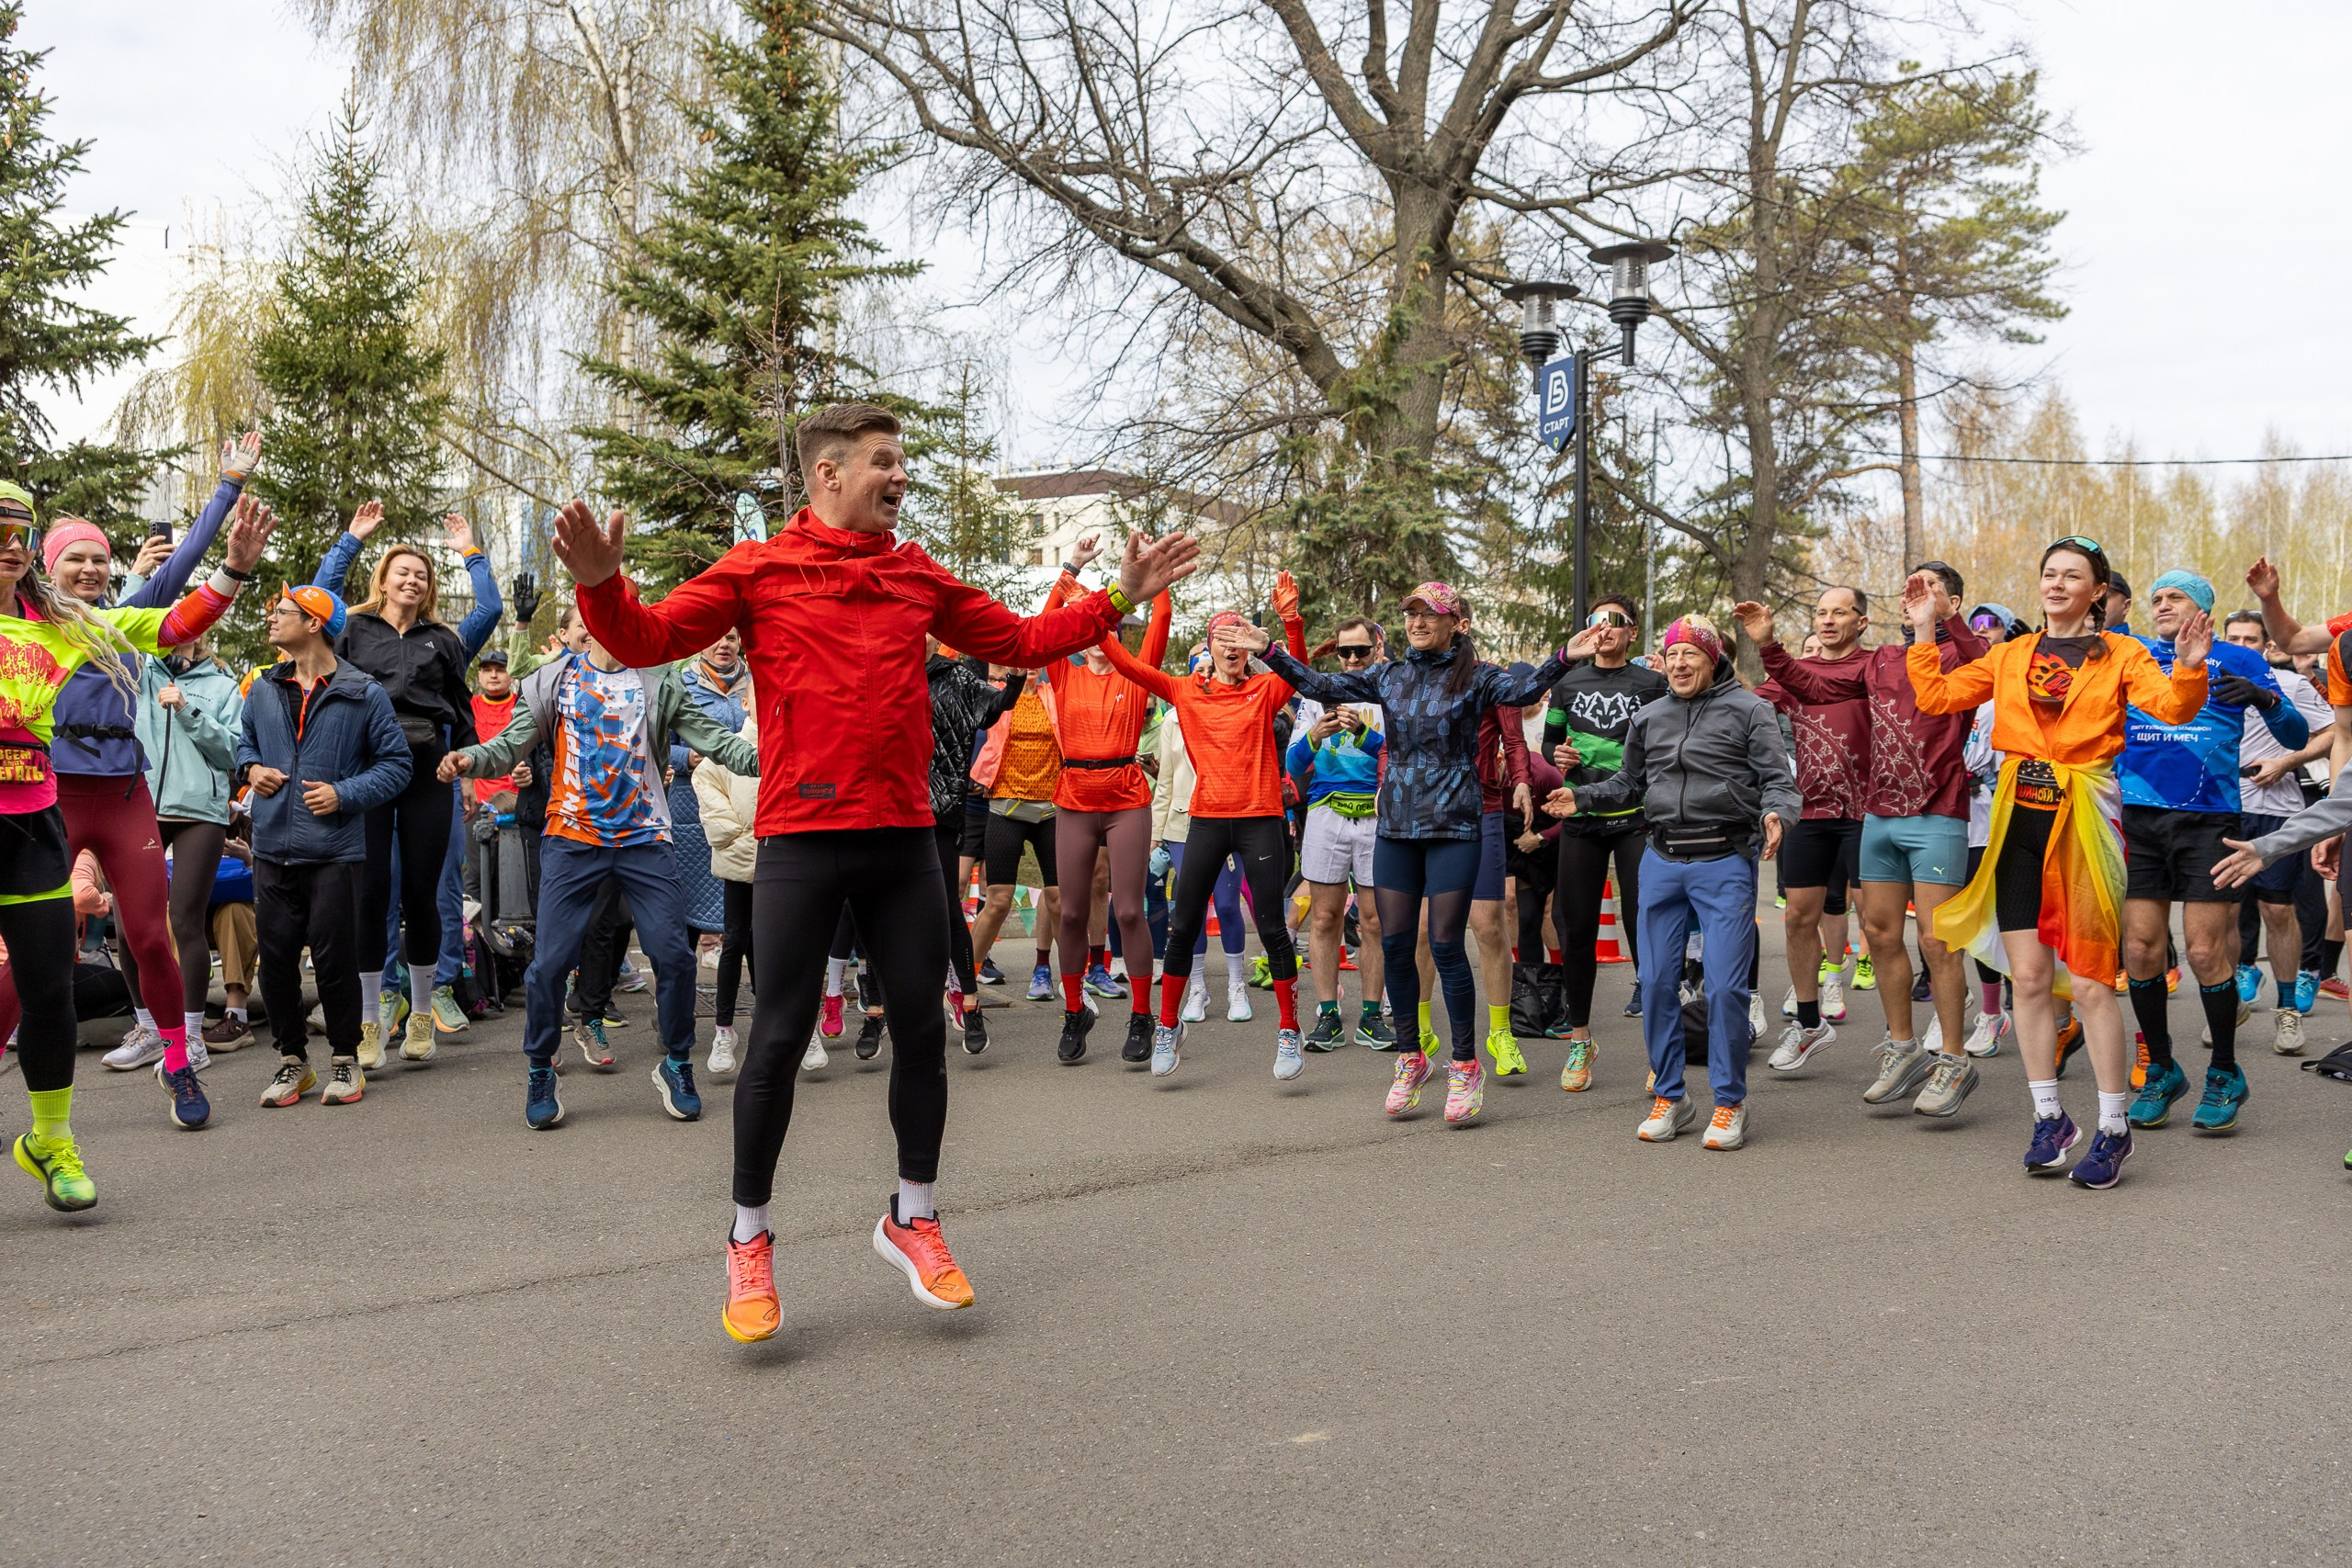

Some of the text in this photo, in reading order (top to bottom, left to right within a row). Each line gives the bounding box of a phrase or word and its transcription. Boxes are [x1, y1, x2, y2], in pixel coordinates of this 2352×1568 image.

[1544, 415, 1570, 434] СТАРТ
[2136, 732, 2199, 743] ЩИТ И МЕЧ
